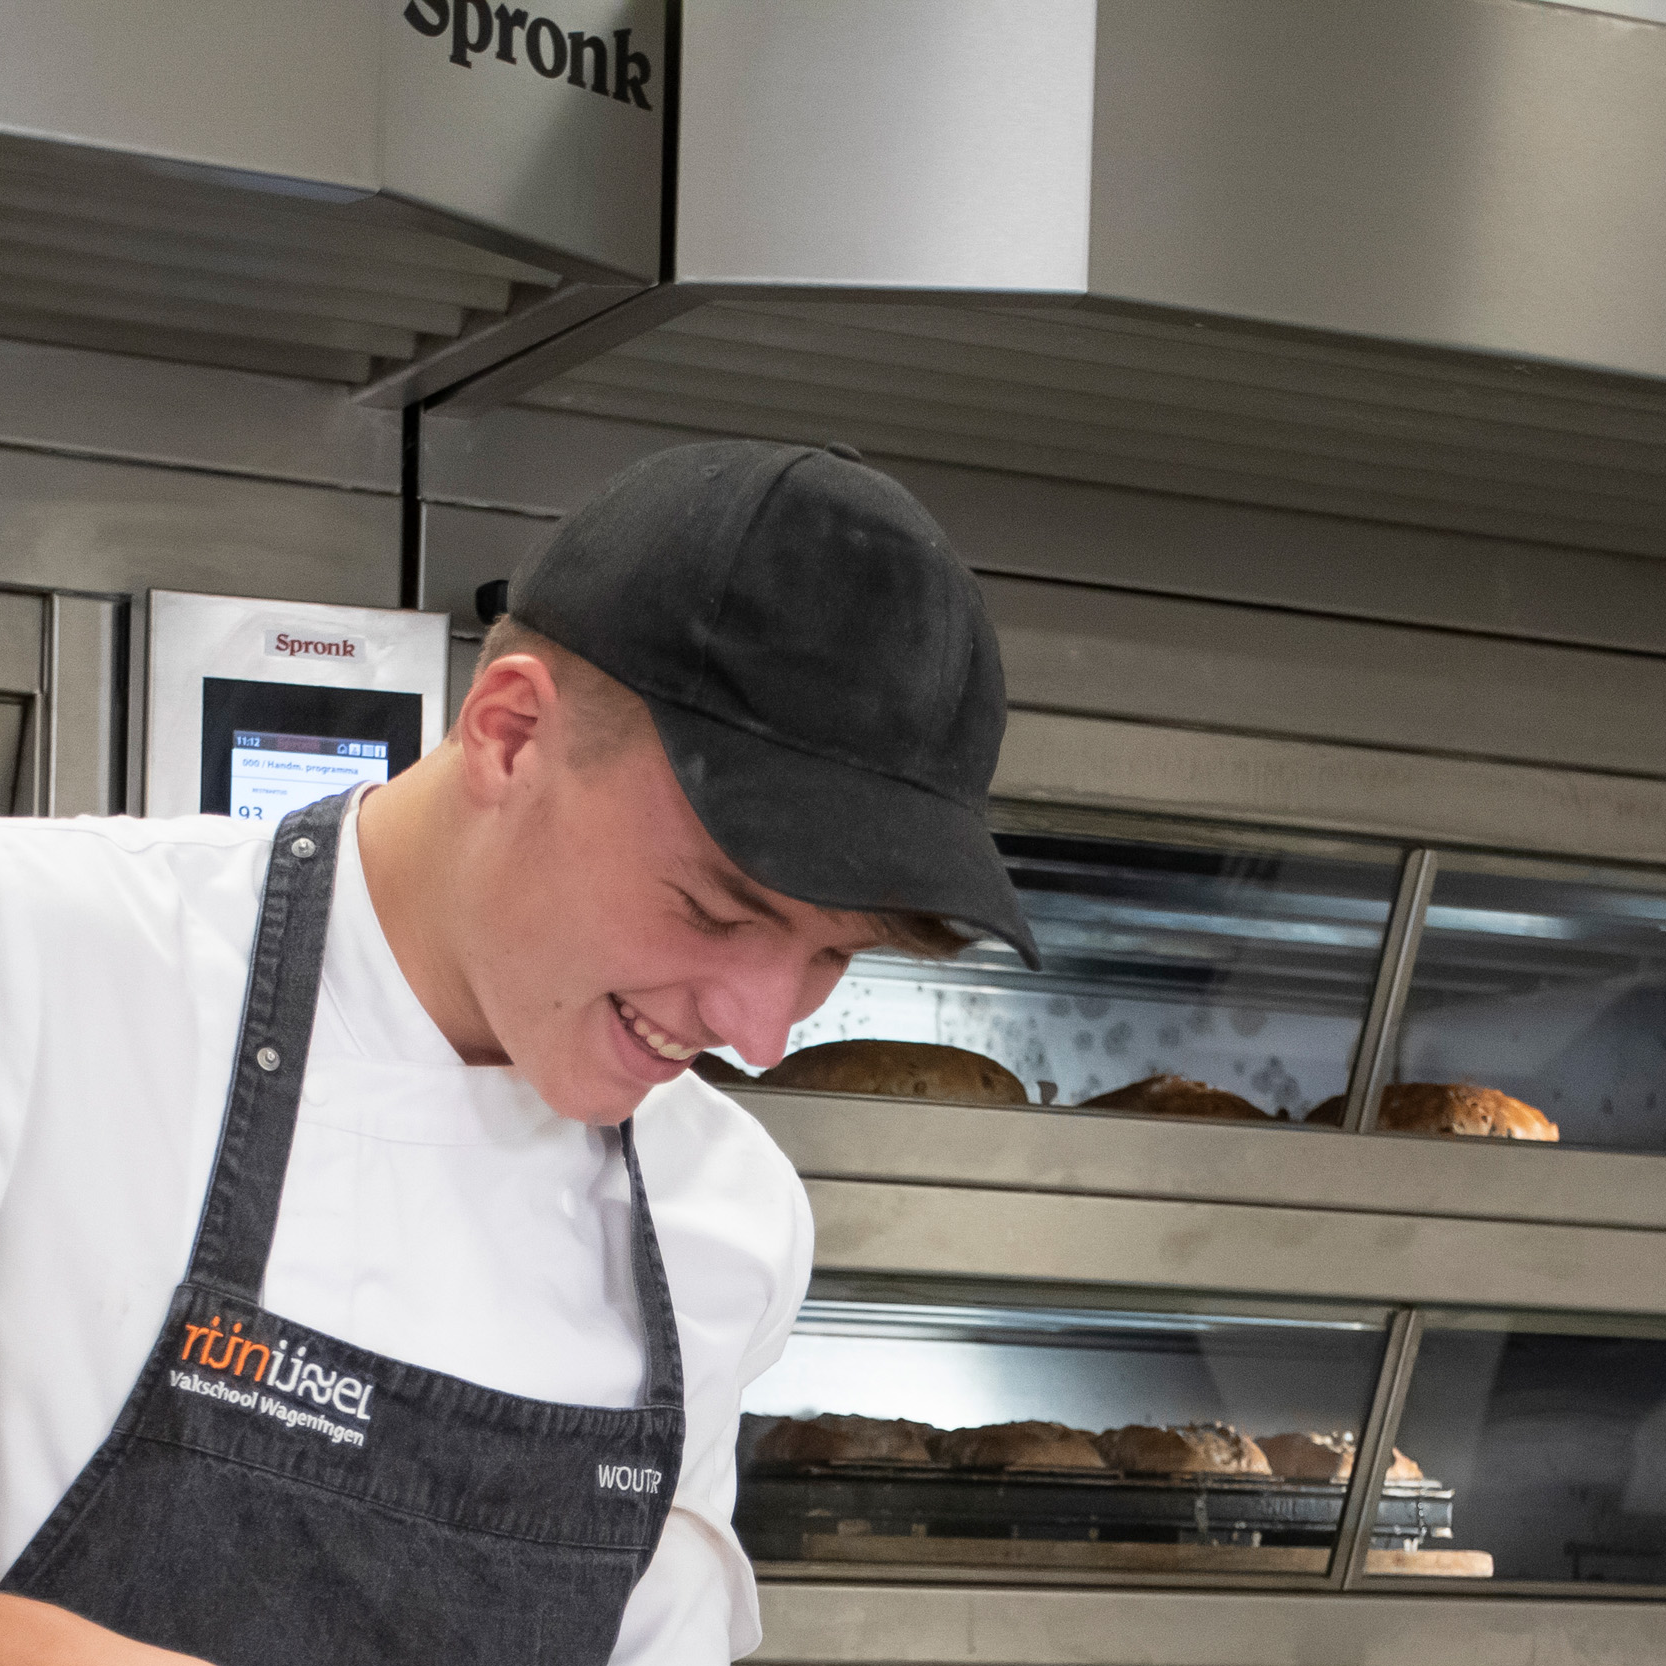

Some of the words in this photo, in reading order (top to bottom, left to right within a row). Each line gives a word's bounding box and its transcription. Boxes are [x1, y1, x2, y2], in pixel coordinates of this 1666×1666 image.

[275, 633, 355, 658] Spronk
[236, 735, 261, 748] 11:12
[305, 764, 359, 776] programma
[169, 1369, 259, 1410] Vakschool
[259, 1395, 365, 1447] Wageningen
